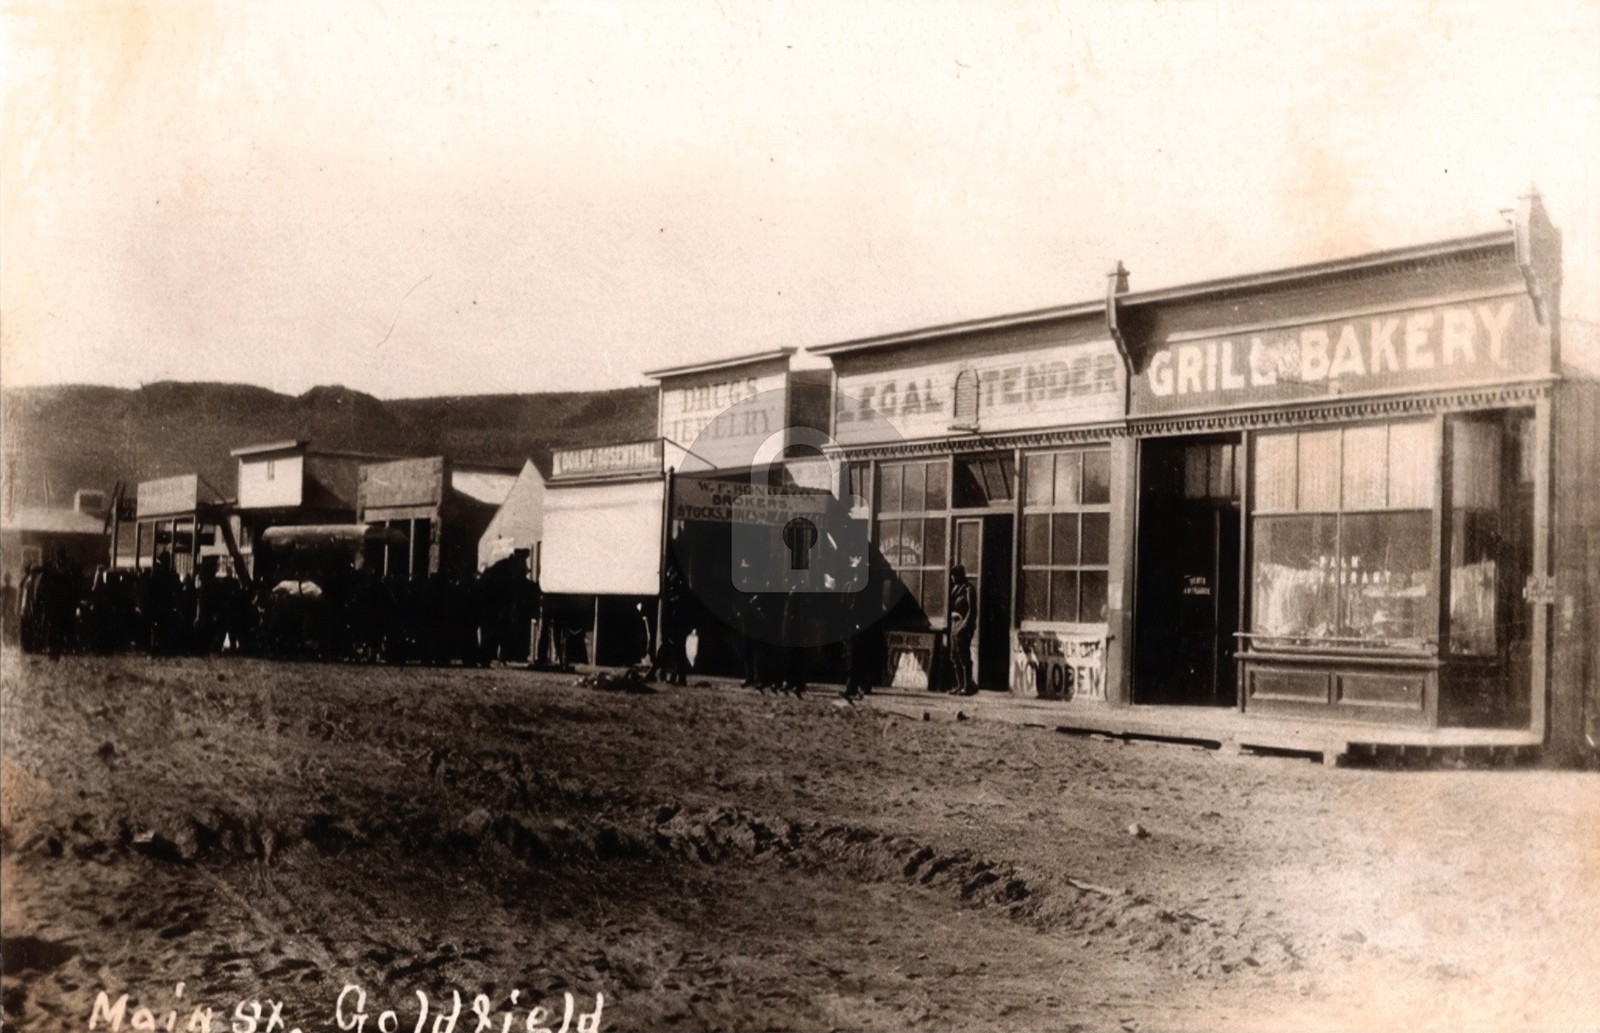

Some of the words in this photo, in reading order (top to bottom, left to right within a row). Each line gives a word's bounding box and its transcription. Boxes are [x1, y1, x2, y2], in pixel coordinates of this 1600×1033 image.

[1147, 335, 1276, 397] GRILL
[1301, 302, 1516, 380] BAKERY
[838, 378, 944, 423] LEGAL
[981, 354, 1118, 408] TENDER
[1306, 568, 1391, 585] TAURANT
[1319, 555, 1360, 569] PALM
[1013, 660, 1049, 697] NOW
[1051, 663, 1102, 697] OPEN
